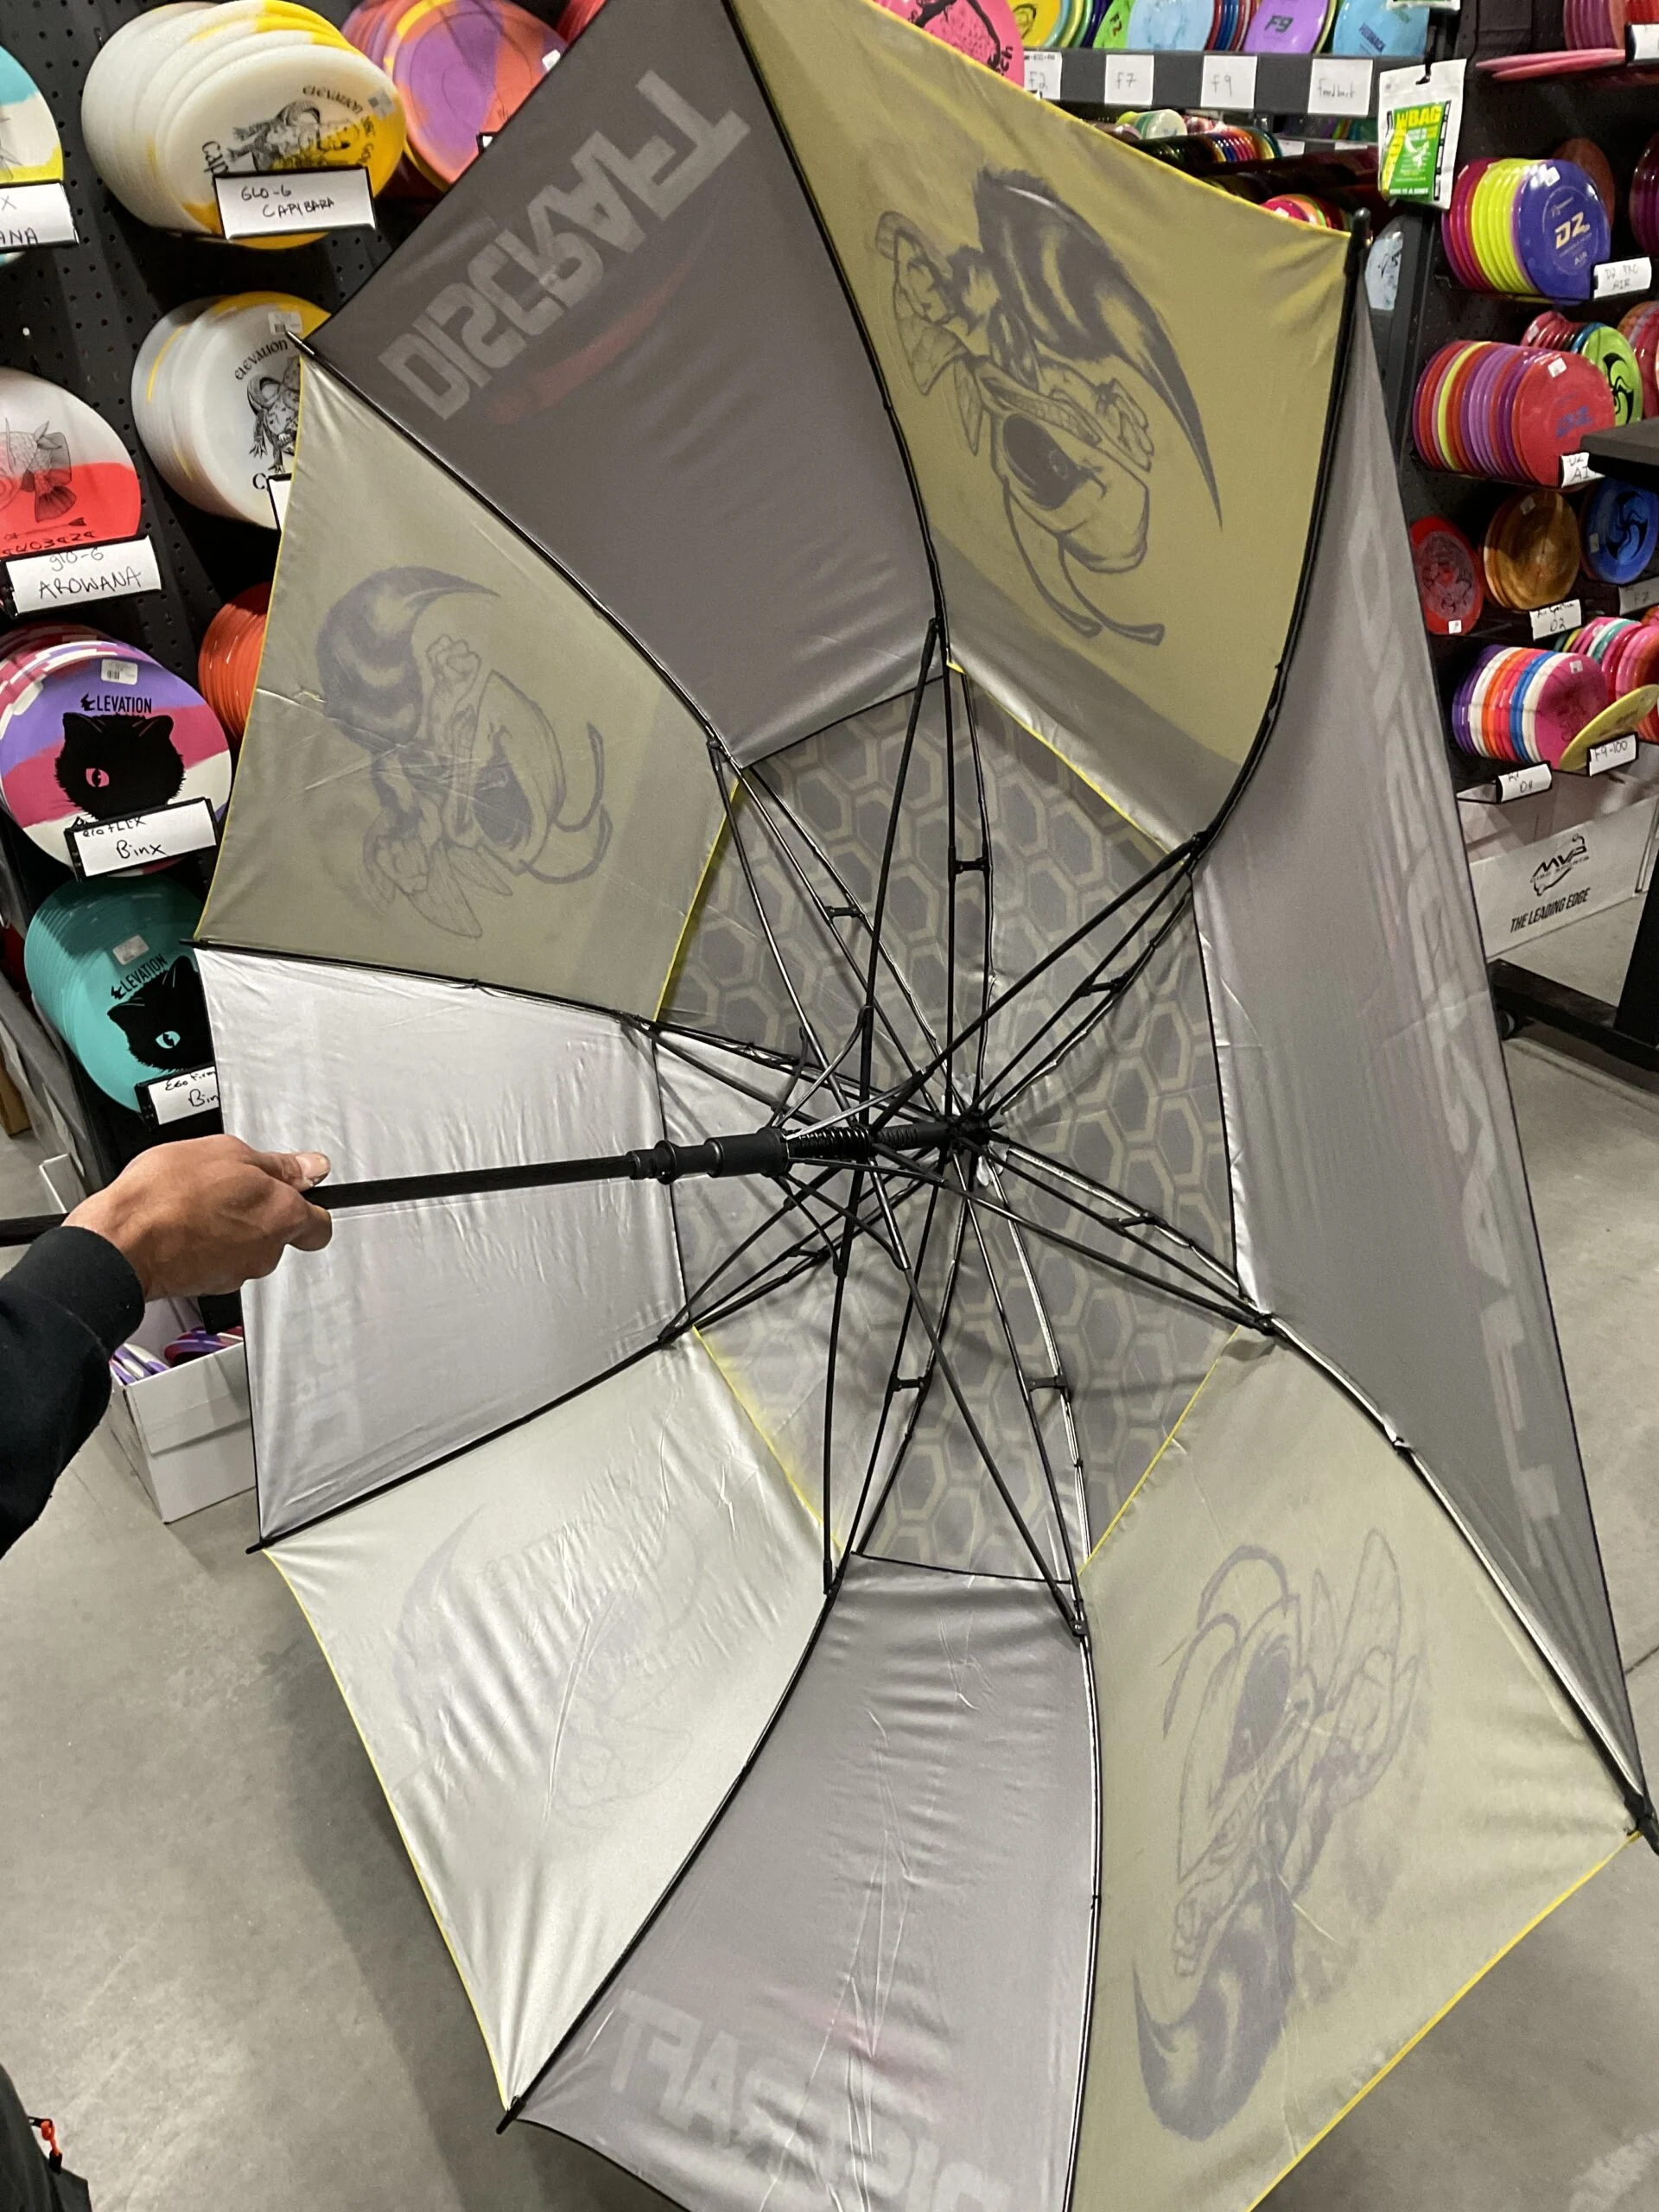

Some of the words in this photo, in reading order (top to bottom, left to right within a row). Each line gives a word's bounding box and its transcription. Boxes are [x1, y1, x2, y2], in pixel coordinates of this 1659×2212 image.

[1264, 15, 1294, 33] F9
[1116, 72, 1137, 90] F7
[1211, 74, 1232, 98] F9
[262, 197, 335, 218] CAPYBARA
[39, 566, 142, 600] AROWANA
[80, 693, 152, 714] ELEVATION
[116, 839, 169, 859] Binx
[1510, 912, 1529, 933] THE
[1528, 897, 1567, 925] LEADING
[1566, 887, 1592, 910] EDGE
[111, 953, 168, 998] ELEVATION
[188, 1088, 219, 1108] Bin
